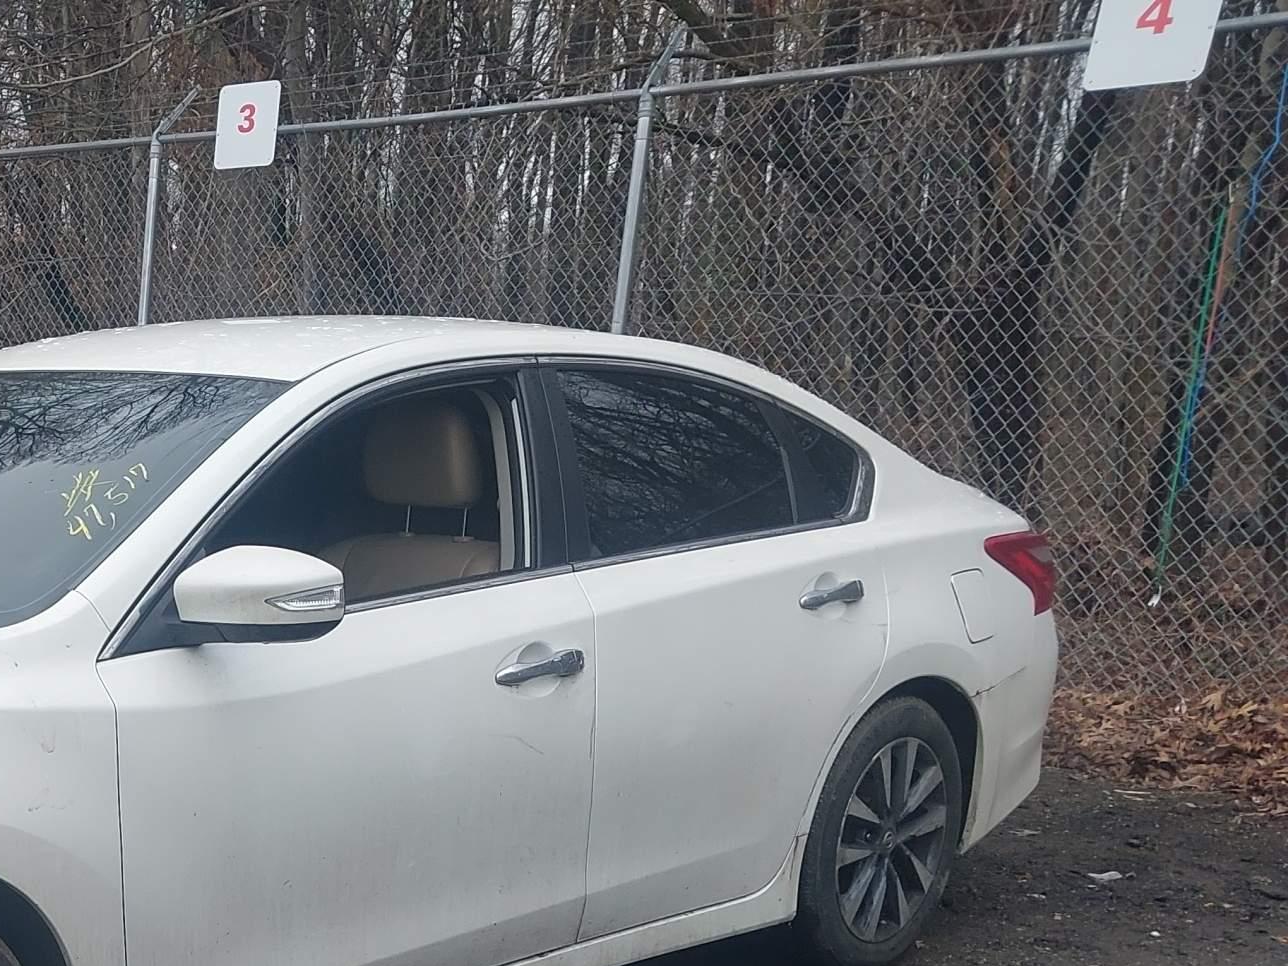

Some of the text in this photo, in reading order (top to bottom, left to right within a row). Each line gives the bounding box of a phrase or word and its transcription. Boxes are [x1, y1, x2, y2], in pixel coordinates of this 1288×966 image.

[1135, 0, 1174, 35] 4
[237, 103, 256, 134] 3
[66, 463, 148, 540] 47,517
